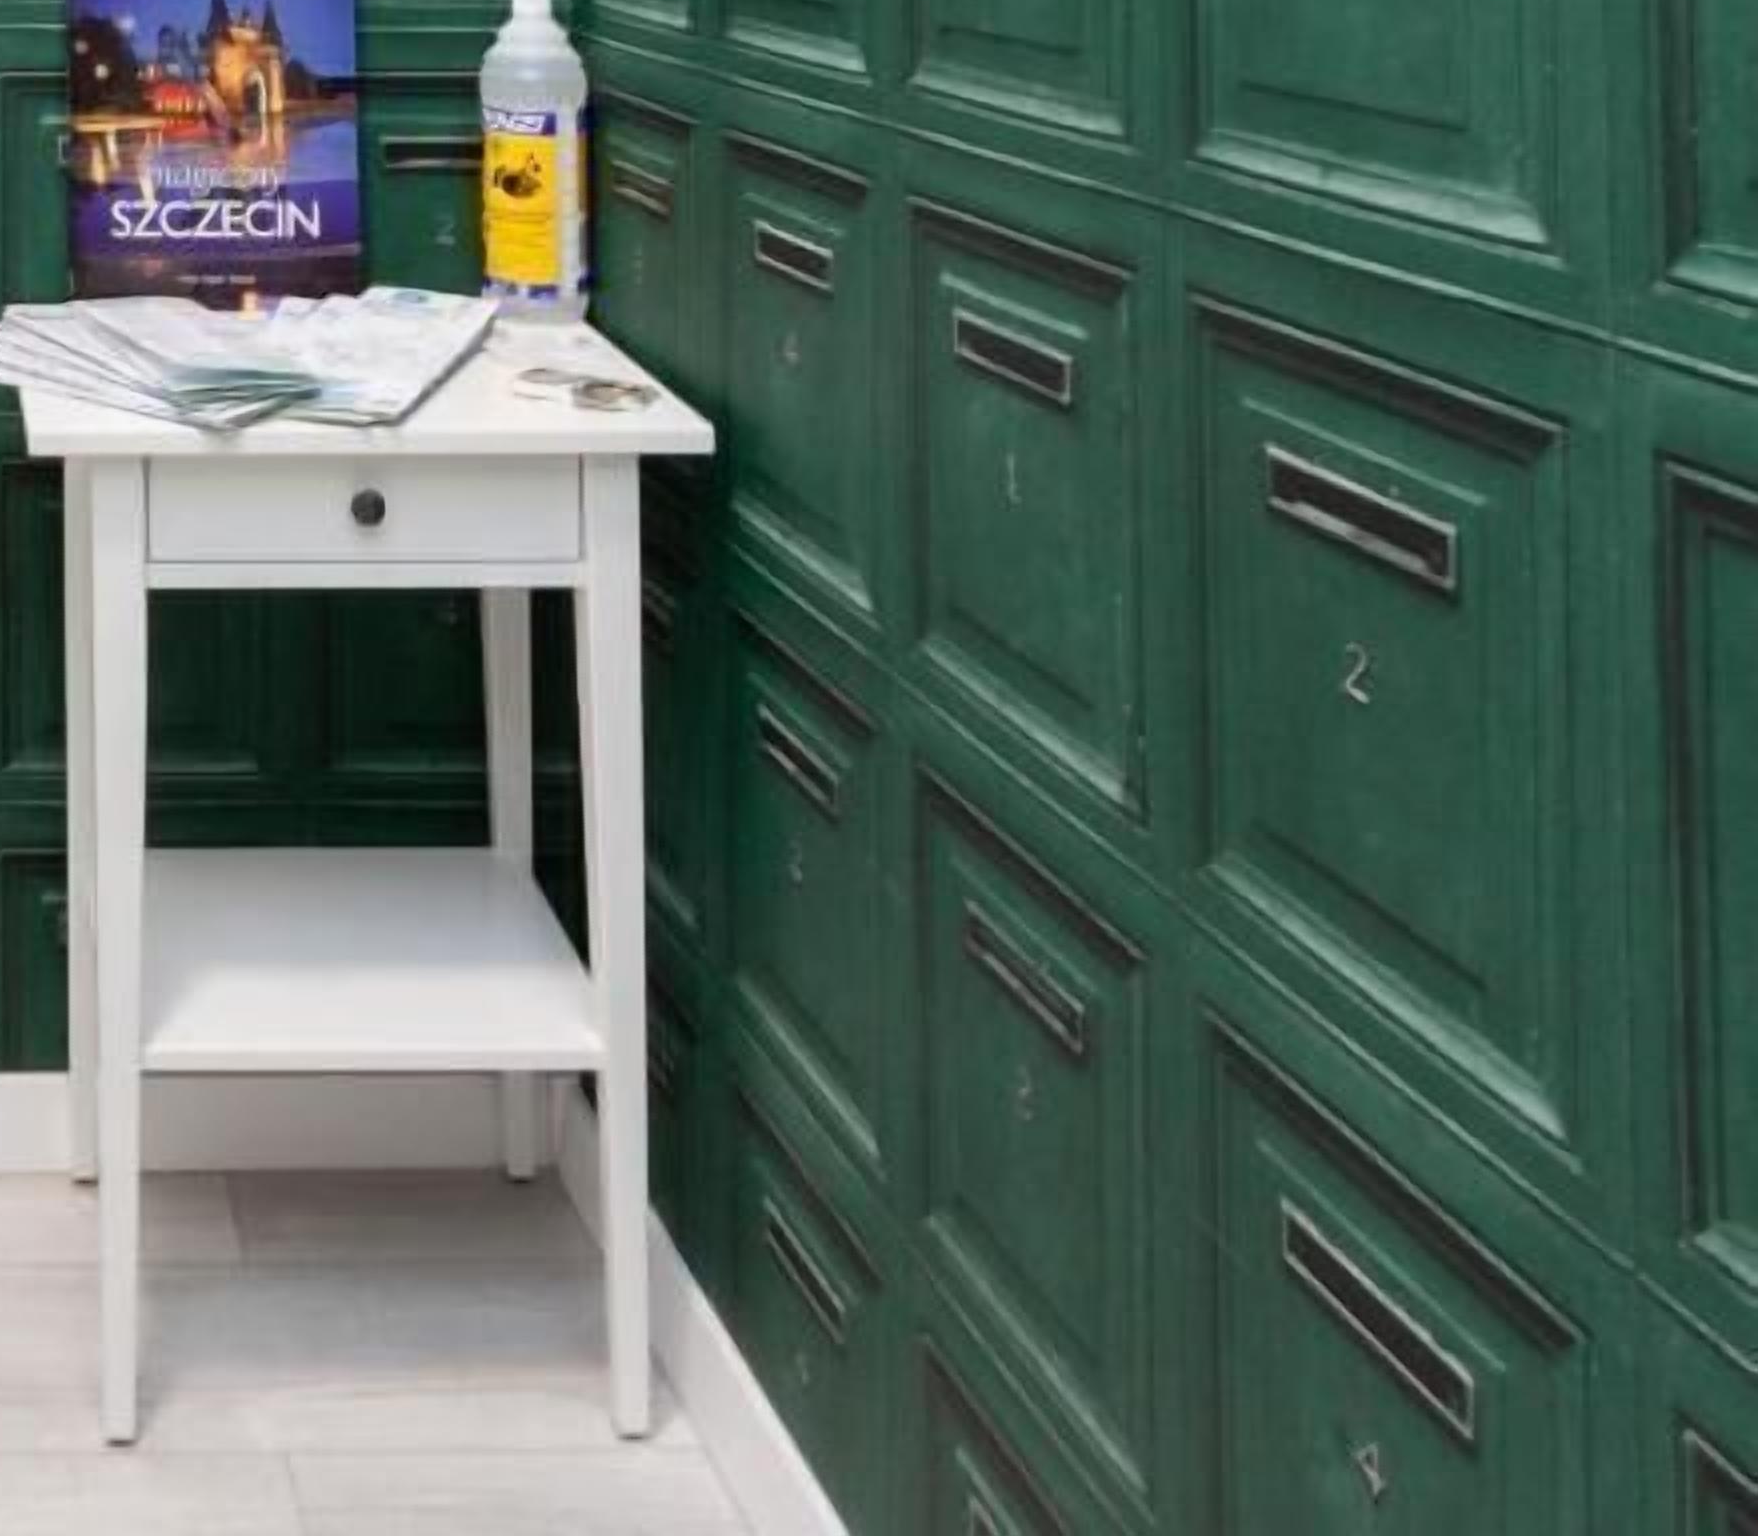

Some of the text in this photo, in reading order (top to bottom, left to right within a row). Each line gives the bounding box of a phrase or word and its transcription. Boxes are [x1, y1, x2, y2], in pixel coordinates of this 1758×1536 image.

[109, 199, 322, 239] SZCZECIN
[1343, 641, 1370, 704] 2
[1355, 1442, 1388, 1504] 4
